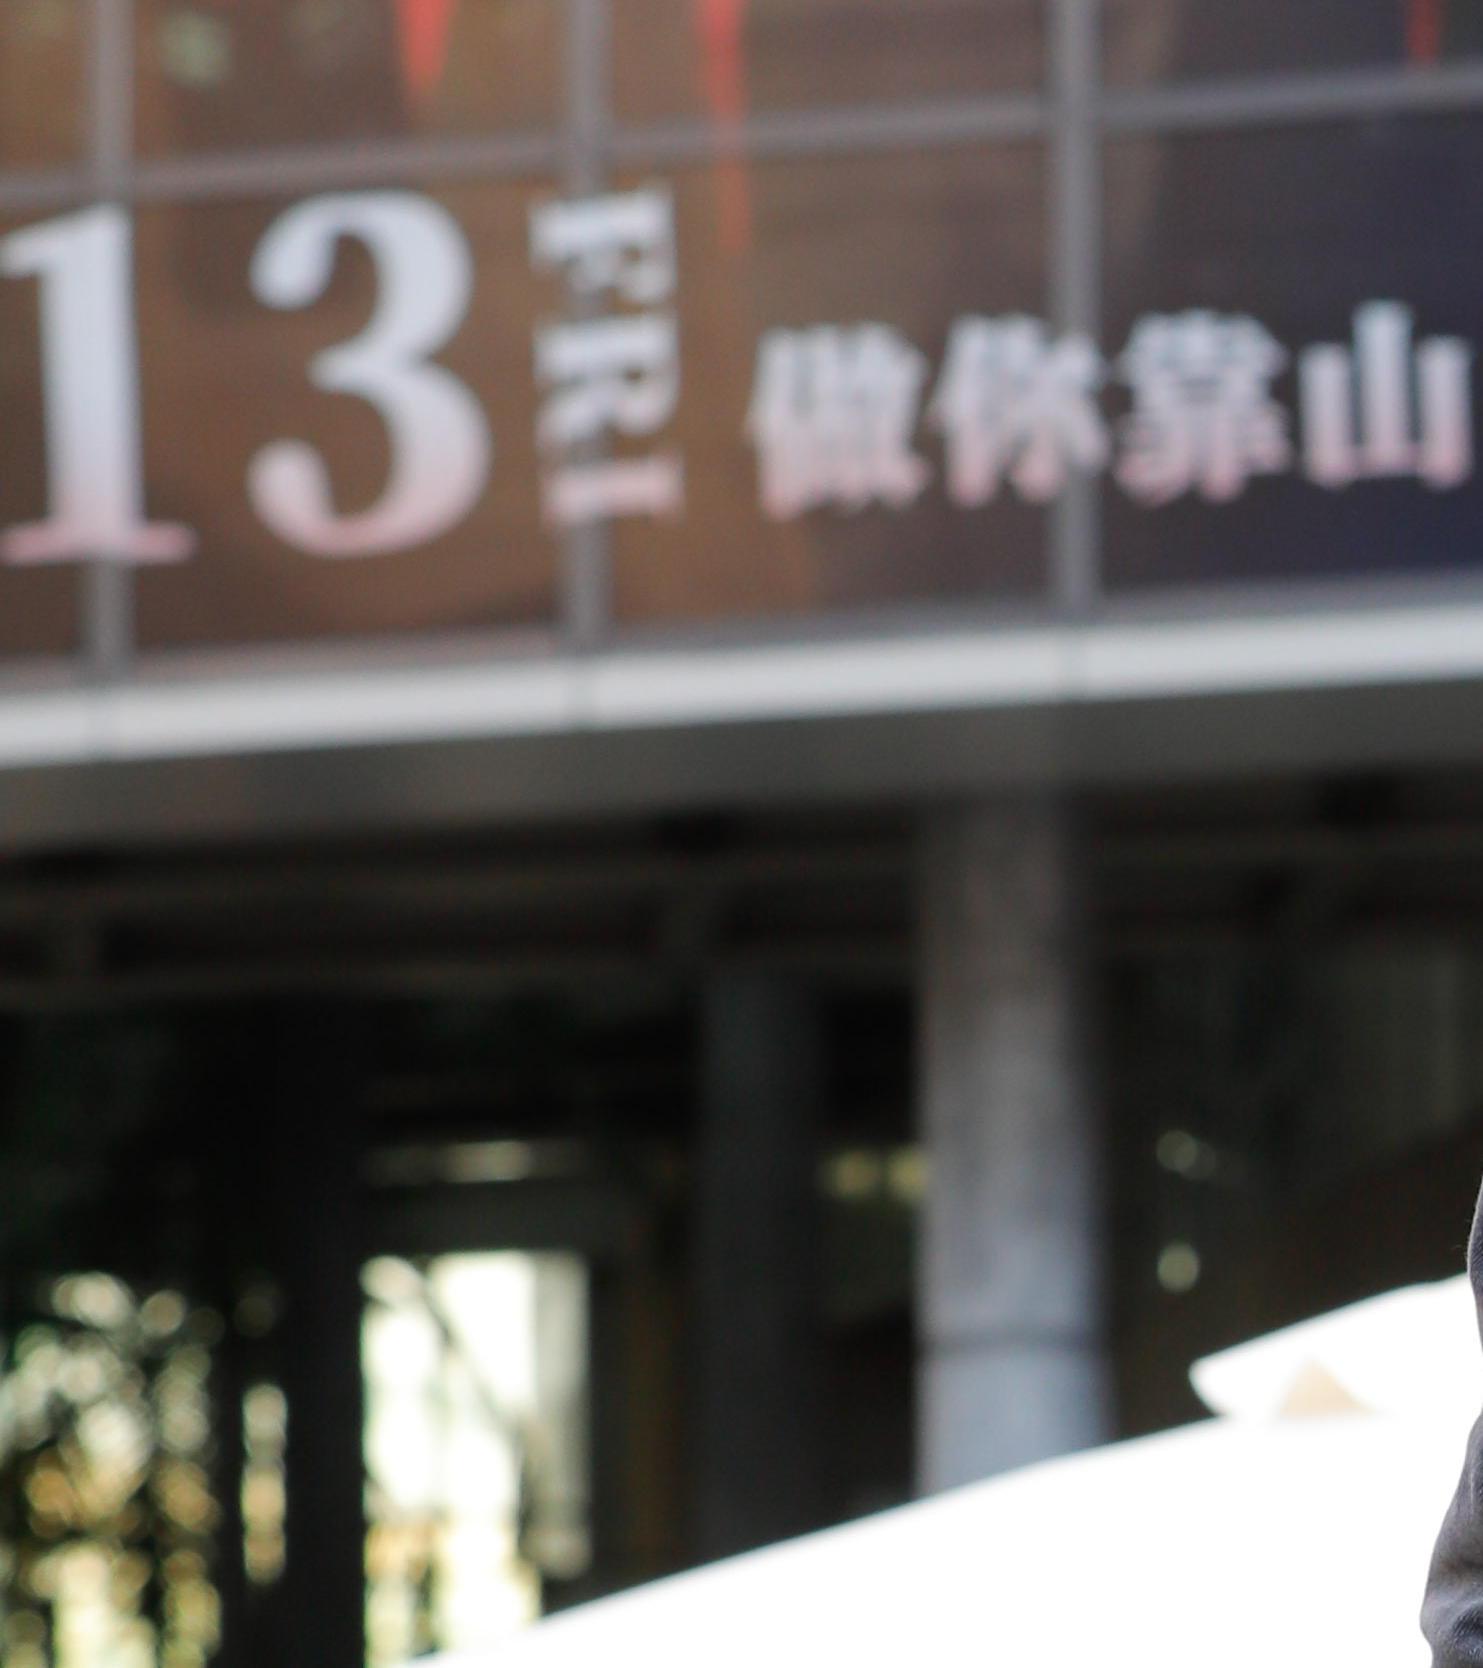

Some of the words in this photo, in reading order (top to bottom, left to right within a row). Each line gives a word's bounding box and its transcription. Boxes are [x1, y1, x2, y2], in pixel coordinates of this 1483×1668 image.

[0, 188, 492, 566] 13
[527, 182, 688, 525] FRI
[747, 300, 1474, 520] 做你靠山
